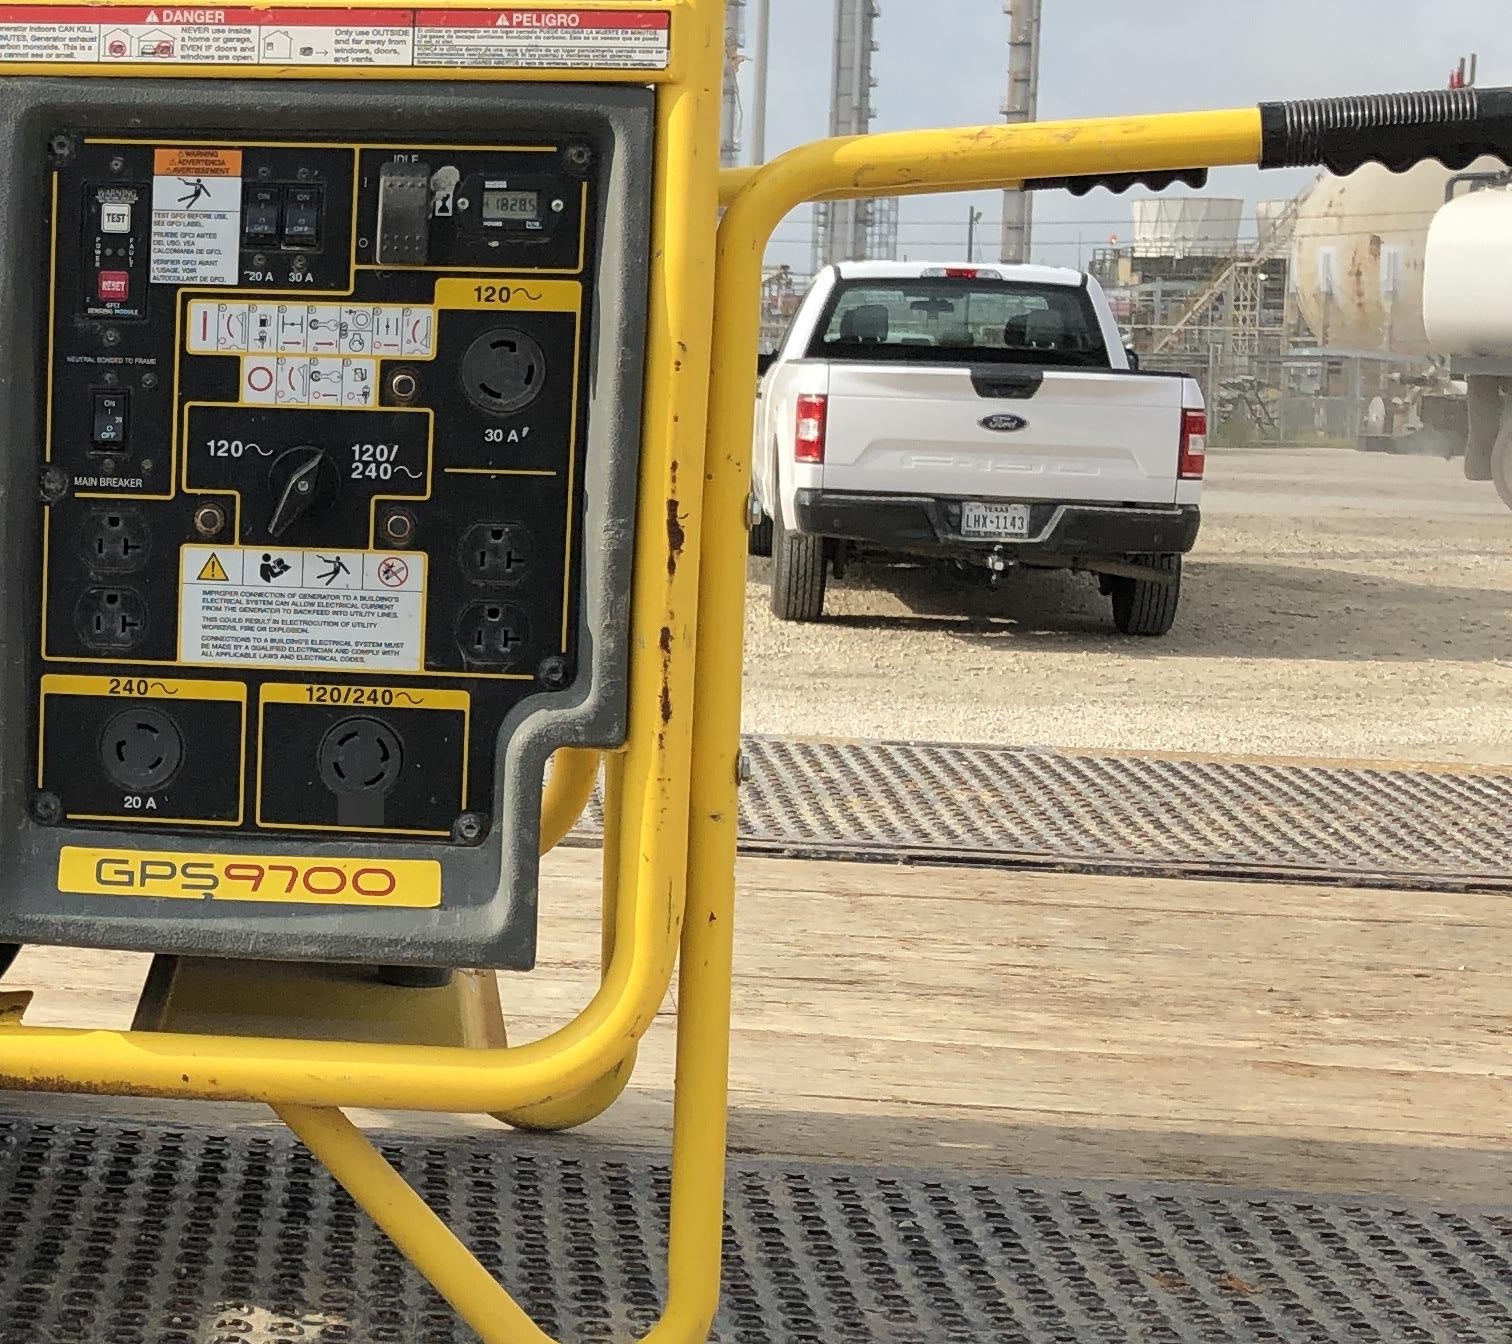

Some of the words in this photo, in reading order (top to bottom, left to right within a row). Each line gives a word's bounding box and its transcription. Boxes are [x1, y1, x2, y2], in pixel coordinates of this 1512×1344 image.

[162, 9, 225, 23] DANGER
[512, 13, 580, 27] PELIGRO
[76, 26, 94, 34] KILL
[227, 27, 252, 35] inside
[334, 29, 353, 37] Only
[371, 29, 409, 37] OUTSIDE
[30, 35, 67, 43] Generator
[68, 35, 97, 43] exhaust
[223, 36, 253, 44] garage,
[364, 39, 386, 47] away
[387, 38, 407, 46] from
[23, 44, 61, 52] monoxide.
[214, 45, 238, 53] doors
[240, 45, 255, 53] and
[334, 47, 372, 55] windows,
[373, 47, 400, 56] doors,
[232, 54, 255, 62] open.
[106, 212, 126, 223] TEST
[248, 271, 263, 282] 20
[264, 271, 274, 282] A
[288, 272, 303, 283] 30
[304, 272, 314, 283] A
[101, 280, 126, 292] RESET
[103, 399, 116, 408] ON
[989, 415, 1018, 429] Ford
[100, 431, 117, 439] OFF
[483, 428, 503, 443] 30
[351, 444, 399, 462] 120/
[74, 476, 98, 487] MAIN
[99, 477, 143, 488] BREAKER
[983, 503, 1009, 513] TEXAS
[240, 590, 286, 598] CONNECTION
[298, 592, 340, 601] GENERATOR
[202, 597, 244, 605] ELECTRICAL
[245, 598, 273, 606] SYSTEM
[275, 599, 290, 607] CAN
[317, 601, 359, 609] ELECTRICAL
[223, 605, 237, 613] THE
[238, 606, 281, 614] GENERATOR
[293, 608, 330, 616] BACKFEED
[331, 609, 349, 617] INTO
[349, 610, 376, 618] UTILITY
[218, 616, 244, 624] COULD
[281, 618, 339, 628] ELECTROCUTION
[351, 621, 378, 629] UTILITY
[201, 635, 251, 643] CONNECTIONS
[252, 636, 262, 644] TO
[310, 639, 352, 647] ELECTRICAL
[354, 640, 383, 648] SYSTEM
[384, 641, 405, 649] MUST
[201, 642, 210, 650] BE
[288, 645, 334, 654] ELECTRICIAN
[334, 647, 349, 655] AND
[350, 648, 380, 656] COMPLY
[381, 649, 400, 657] WITH
[201, 650, 213, 658] ALL
[215, 651, 258, 659] APPLICABLE
[280, 653, 295, 661] AND
[296, 654, 338, 662] ELECTRICAL
[122, 795, 142, 809] 20
[145, 796, 157, 810] A
[95, 858, 397, 897] GPS9700
